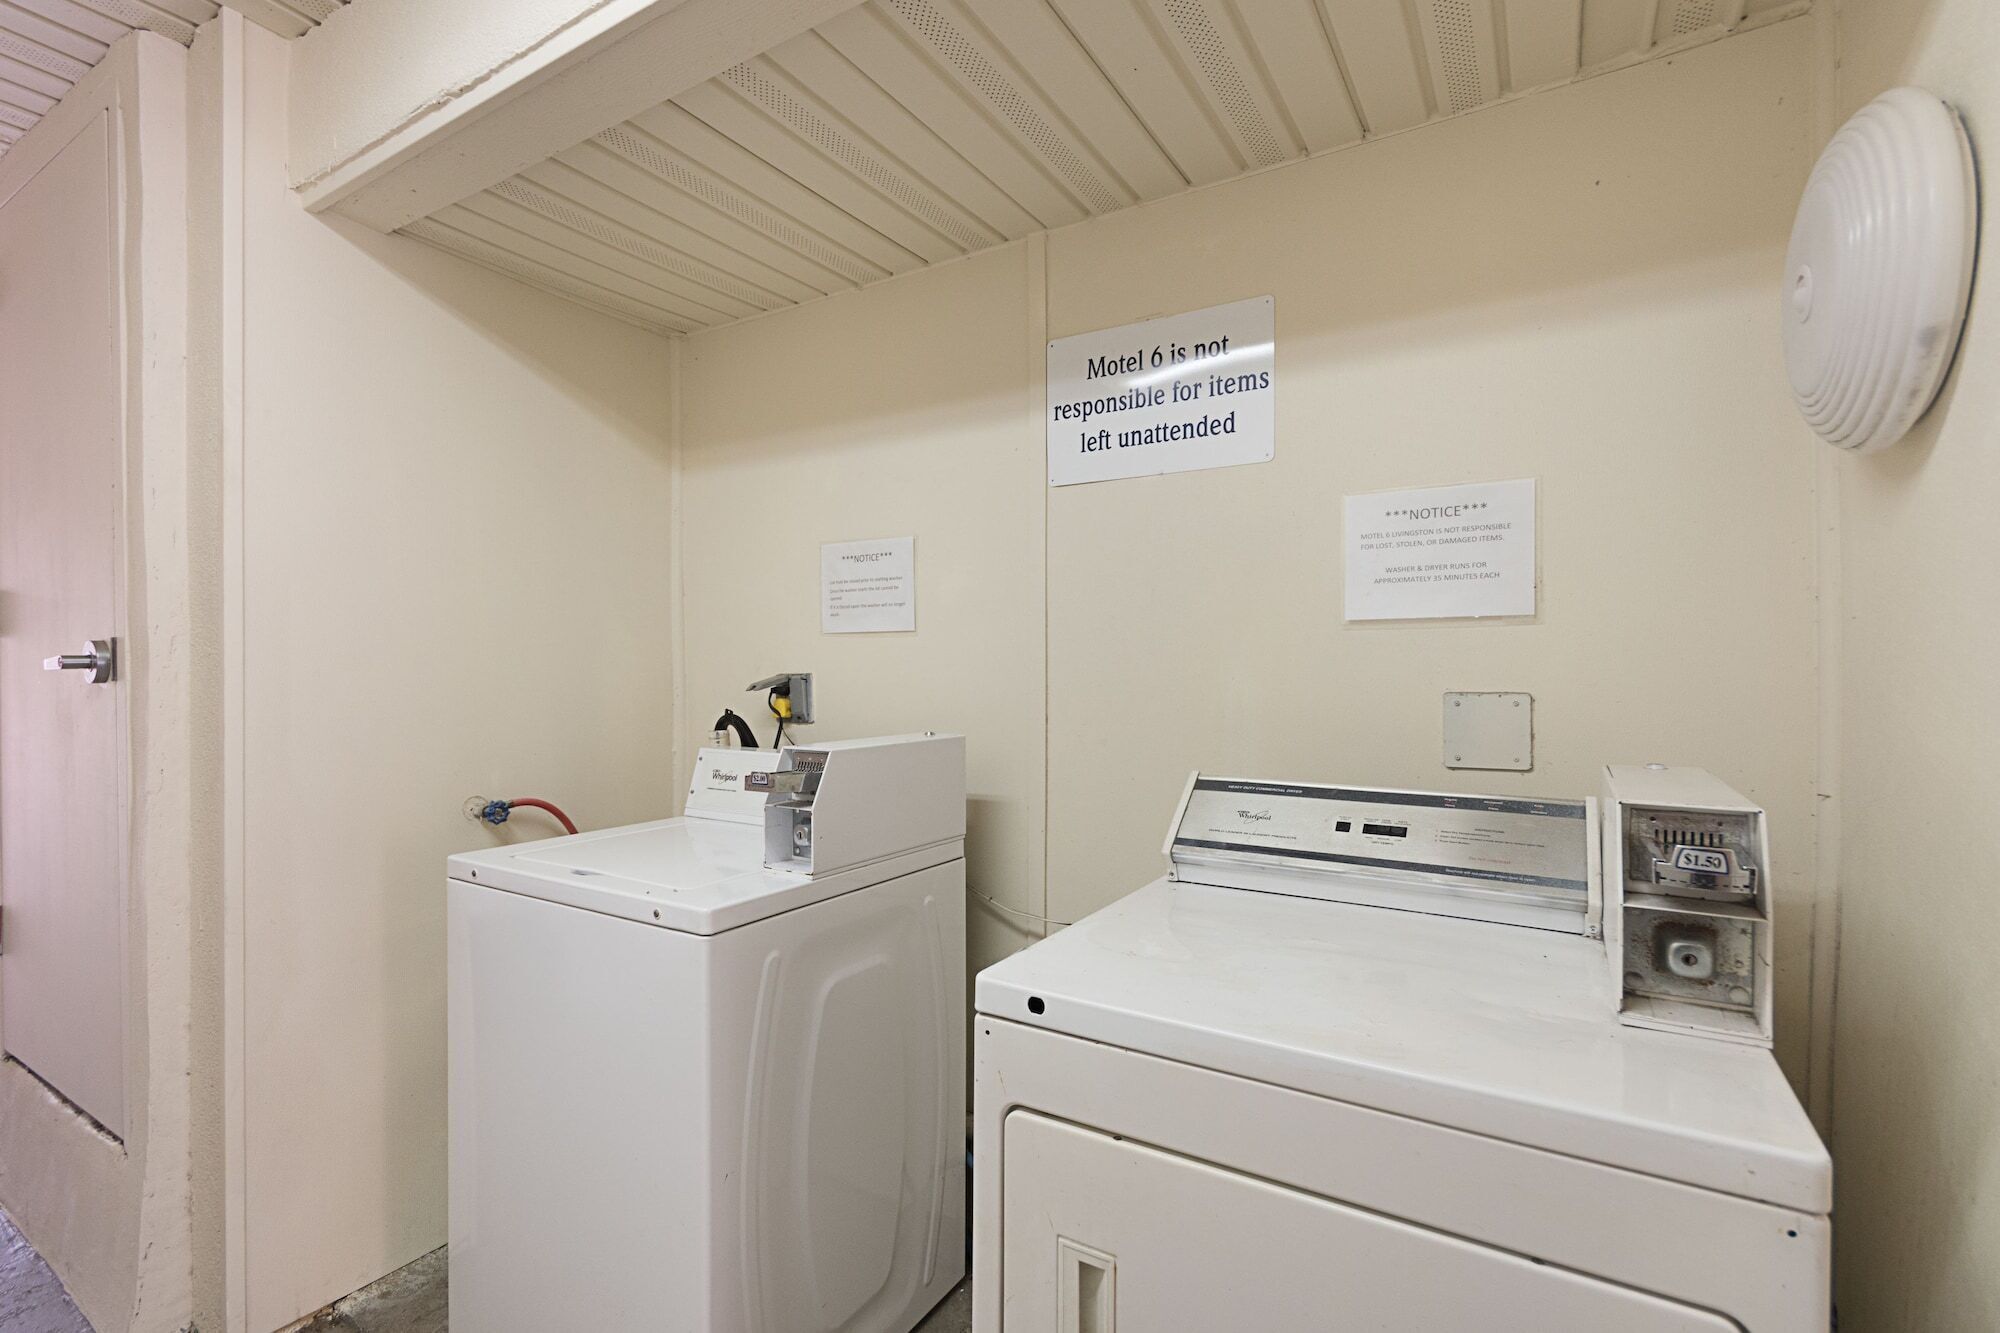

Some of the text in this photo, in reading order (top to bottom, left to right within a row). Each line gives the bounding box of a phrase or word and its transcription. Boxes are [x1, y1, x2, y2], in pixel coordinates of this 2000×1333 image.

[1087, 335, 1230, 380] Motel 6 is not
[1053, 371, 1270, 422] responsible for items
[1081, 411, 1236, 453] left unattended
[1360, 532, 1384, 540] MOTEL
[1392, 528, 1434, 538] LIVINGSTON
[1444, 526, 1460, 534] NOT
[1462, 522, 1512, 532] RESPONSIBLE
[1439, 536, 1477, 545] DAMAGED
[1472, 561, 1487, 569] FOR
[1374, 576, 1431, 584] APPROXIMATELY
[1444, 573, 1478, 581] MINUTES
[712, 772, 738, 783] Whirlpool
[1239, 812, 1271, 821] Whirlpool
[1684, 852, 1722, 869] $1.50
